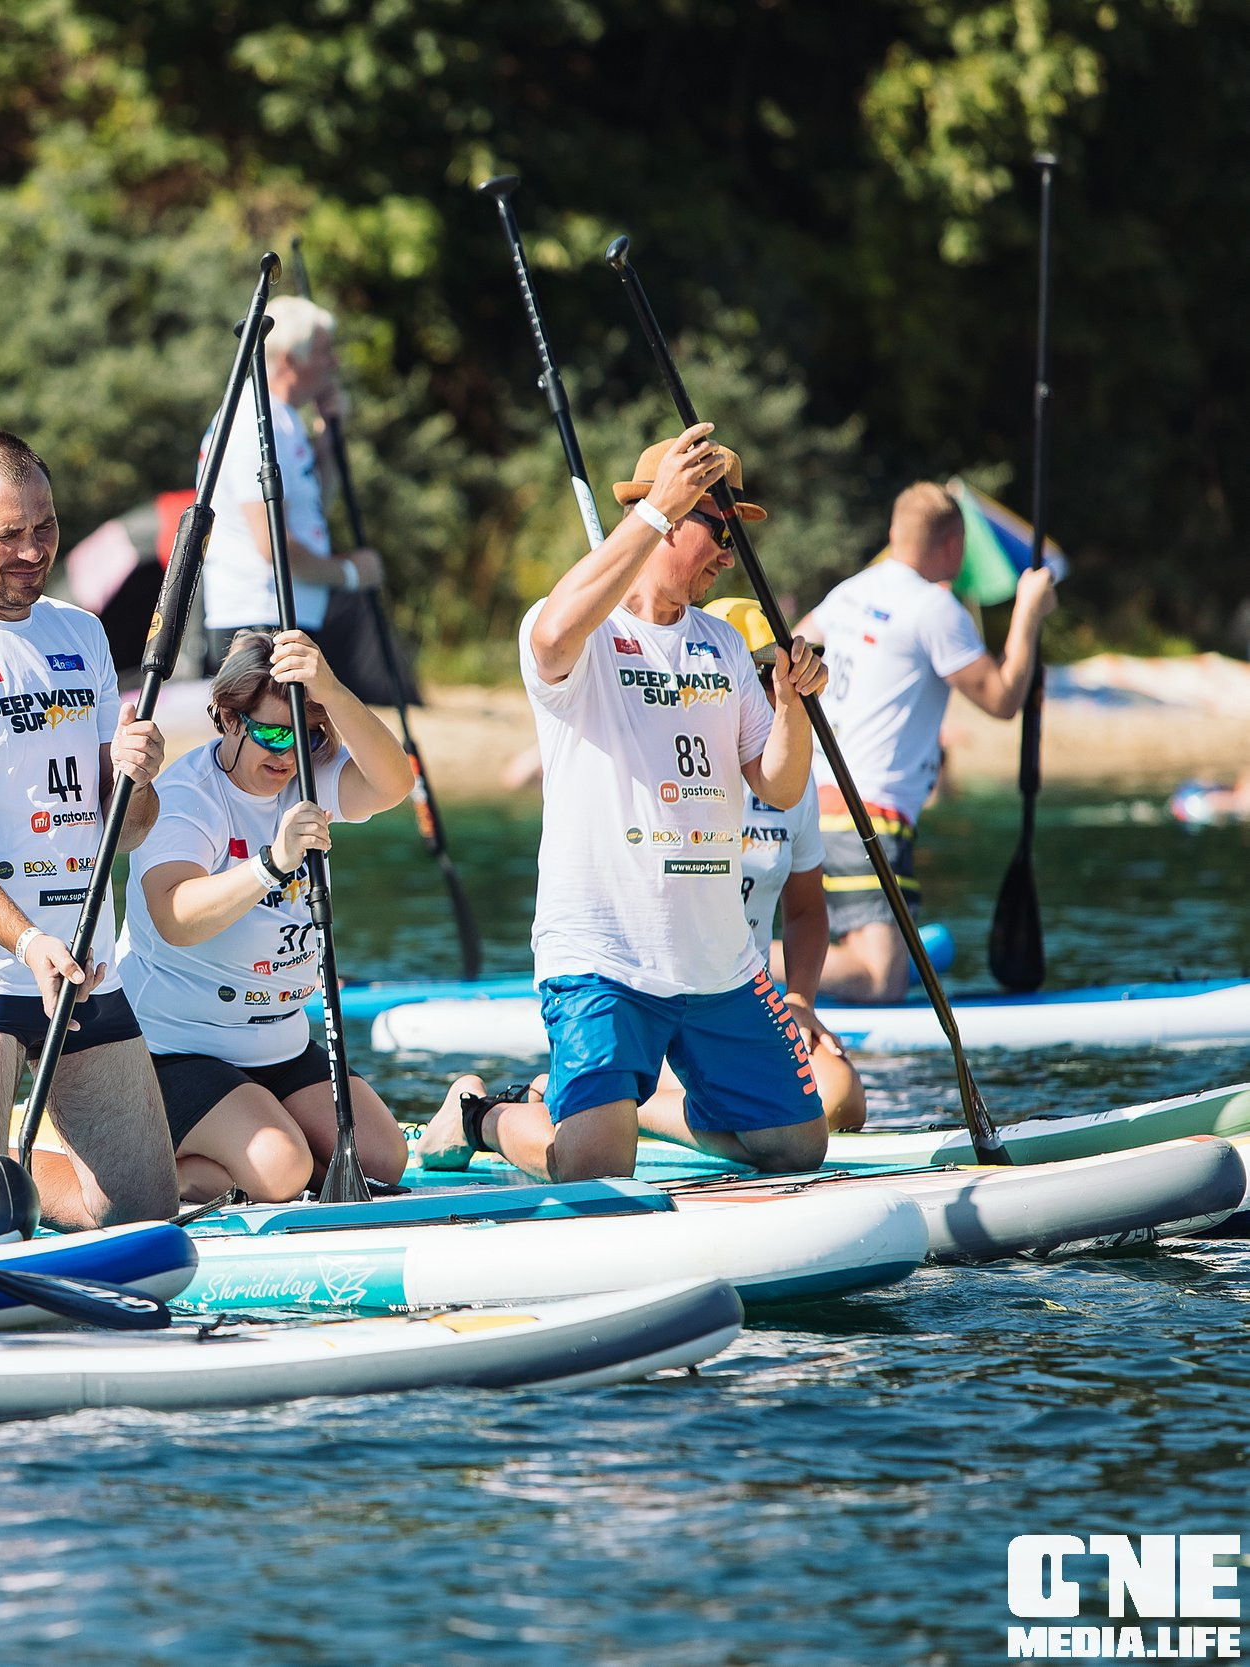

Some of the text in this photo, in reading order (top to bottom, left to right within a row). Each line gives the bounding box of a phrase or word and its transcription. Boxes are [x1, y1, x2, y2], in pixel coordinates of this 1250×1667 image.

[618, 669, 732, 692] DEEP WATER
[33, 689, 96, 710] WATER
[643, 688, 681, 706] SUP
[10, 711, 47, 733] SUP
[675, 734, 712, 778] 83
[48, 756, 83, 802] 44
[46, 890, 86, 903] www.sup4
[256, 890, 285, 908] UP
[202, 1269, 318, 1304] Shridinlay
